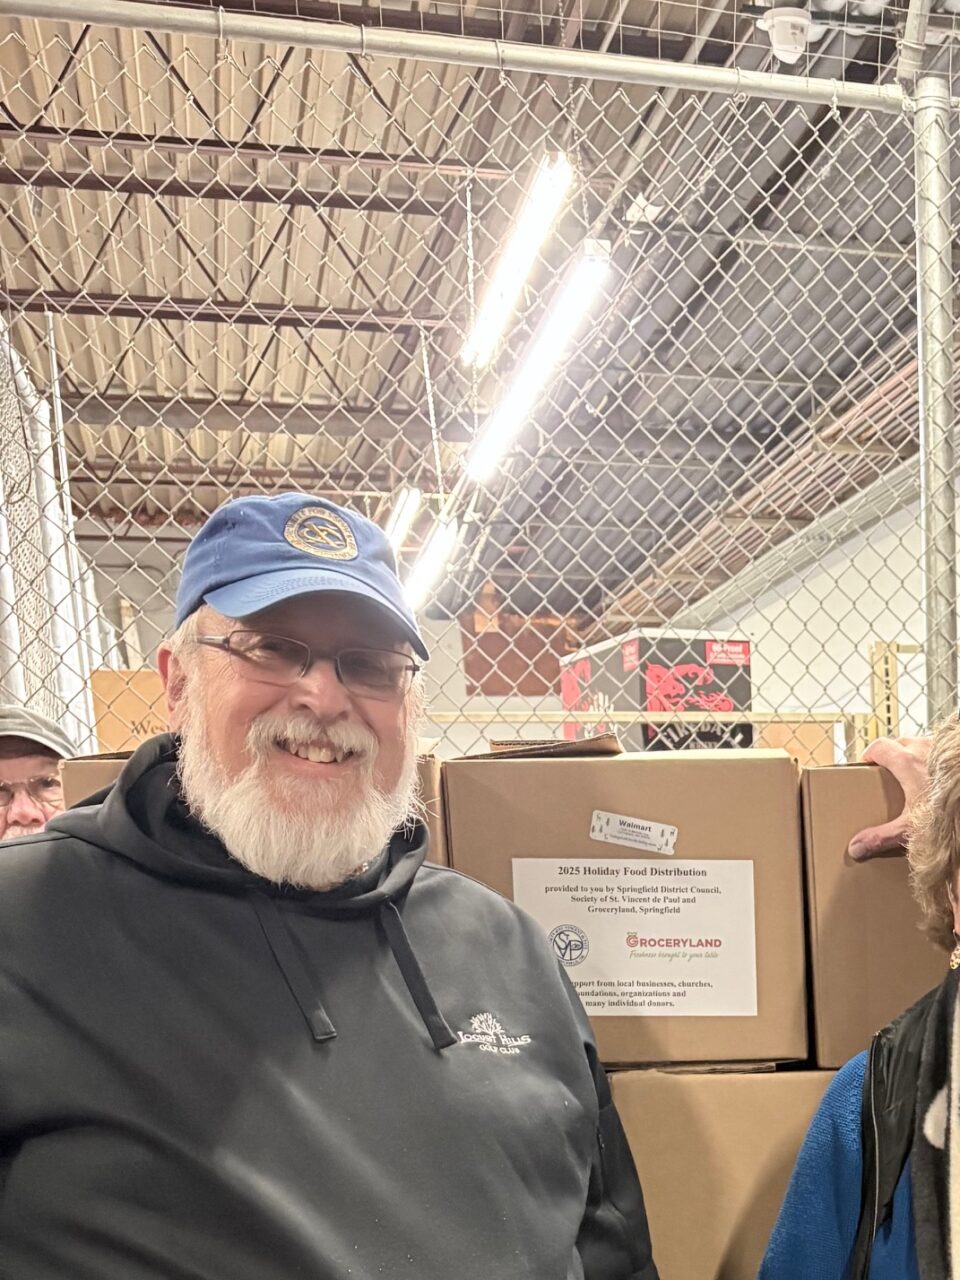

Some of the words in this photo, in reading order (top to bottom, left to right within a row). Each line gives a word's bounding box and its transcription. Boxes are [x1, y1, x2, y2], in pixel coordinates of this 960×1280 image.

[618, 819, 653, 832] Walmart
[558, 866, 580, 875] 2025
[583, 866, 620, 878] Holiday
[623, 866, 647, 876] Food
[650, 867, 707, 877] Distribution
[544, 885, 579, 894] provided
[581, 885, 588, 893] to
[590, 886, 604, 894] you
[605, 885, 614, 894] by
[617, 885, 659, 895] Springfield
[660, 886, 688, 894] District
[690, 886, 722, 894] Council,
[570, 895, 598, 904] Society
[600, 895, 608, 903] of
[609, 895, 620, 903] St.
[621, 896, 650, 904] Vincent
[652, 896, 662, 904] de
[663, 896, 680, 904] Paul
[681, 896, 697, 904] and
[587, 905, 637, 915] Groceryland,
[639, 905, 681, 915] Springfield
[625, 934, 722, 948] GROCERYLAND
[572, 980, 595, 989] pport
[596, 979, 615, 988] from
[636, 980, 677, 988] businesses,
[677, 980, 714, 988] churches,
[620, 990, 671, 998] organizations
